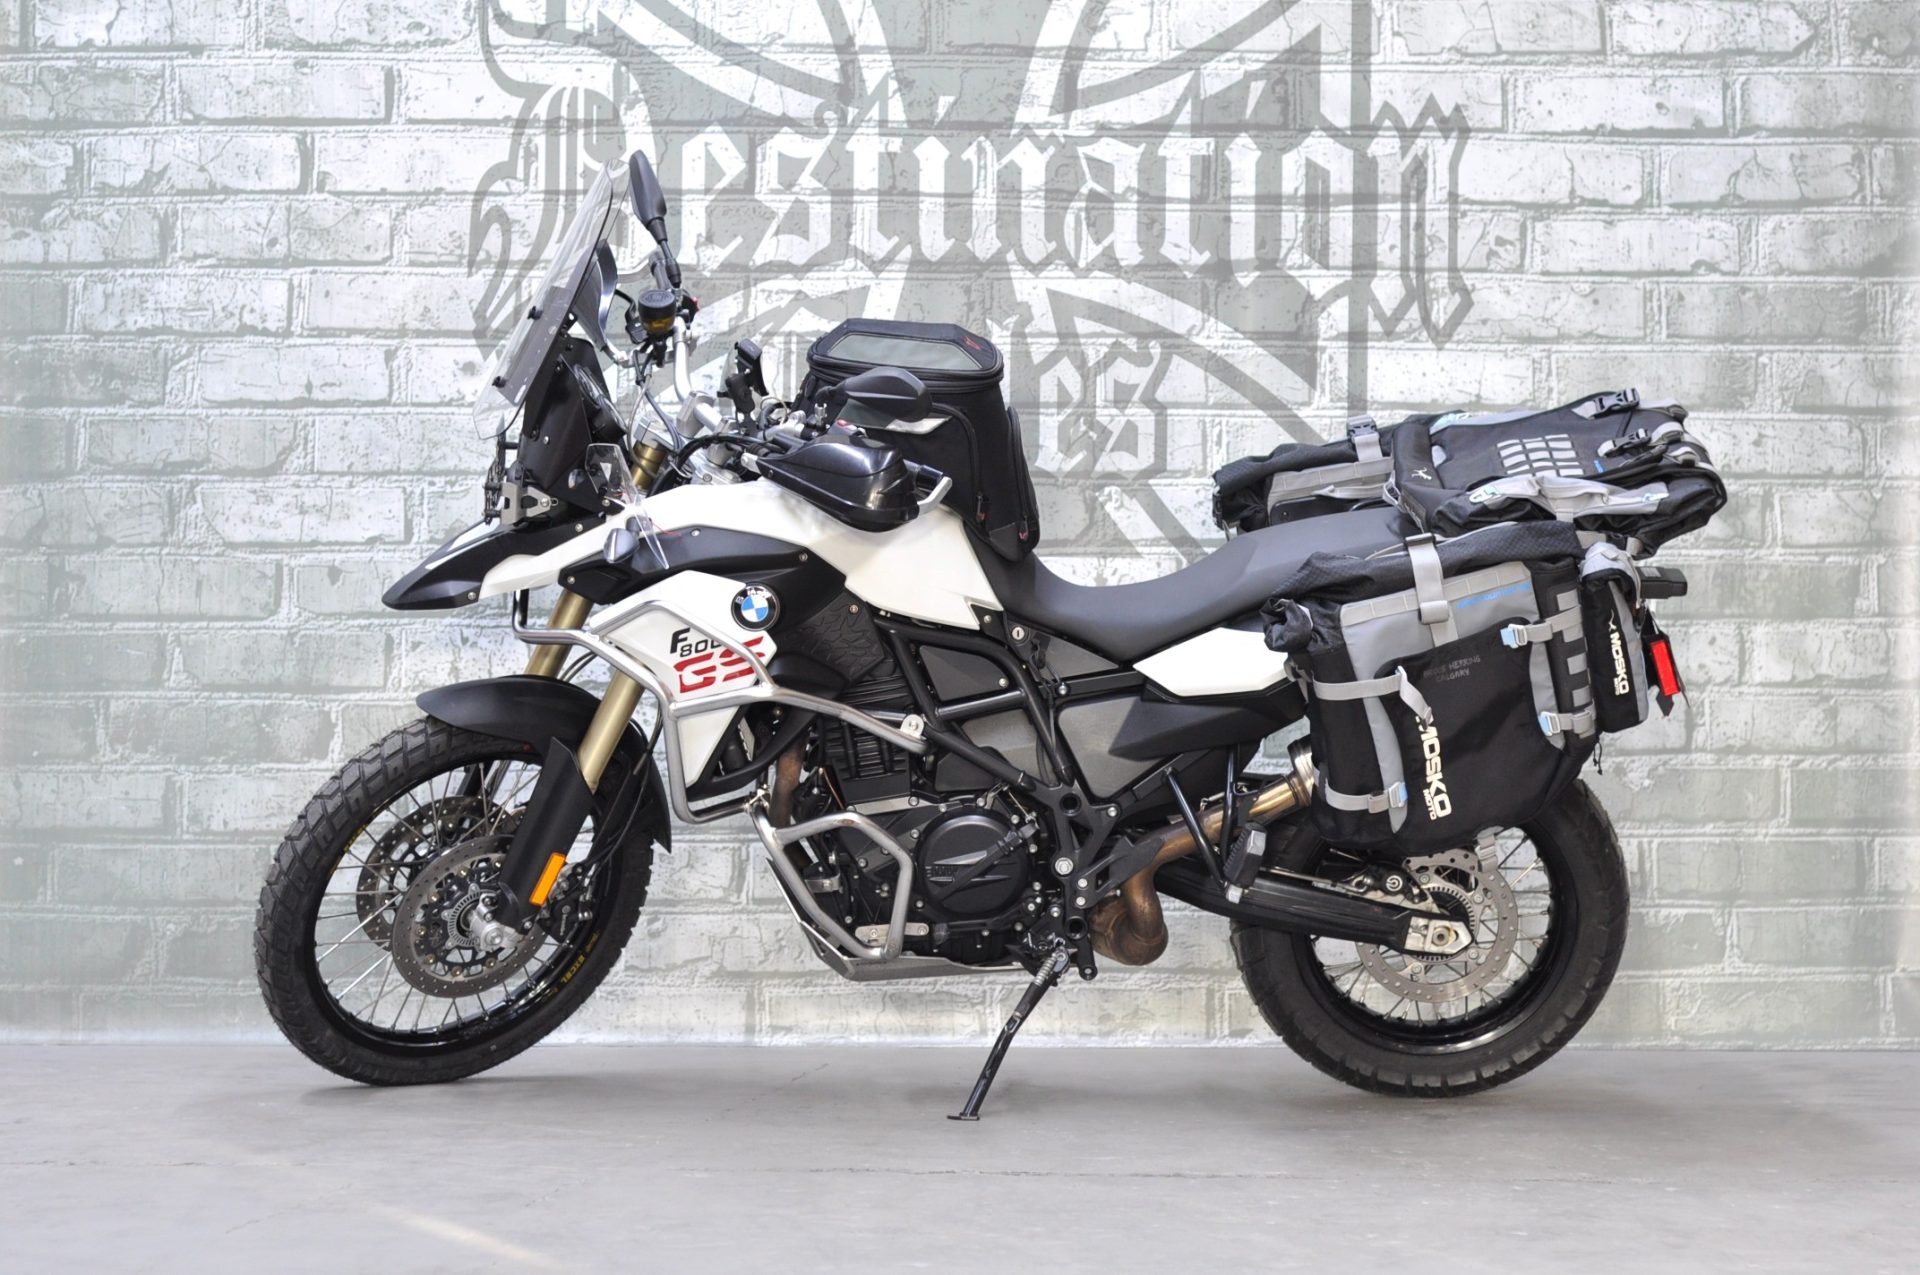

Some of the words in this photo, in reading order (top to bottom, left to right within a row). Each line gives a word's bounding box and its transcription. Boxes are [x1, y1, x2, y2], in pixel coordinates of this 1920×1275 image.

[735, 586, 772, 604] BMW
[670, 627, 691, 654] F
[673, 636, 766, 693] GS
[1610, 631, 1629, 695] MOSKO
[1422, 788, 1437, 820] MOTO
